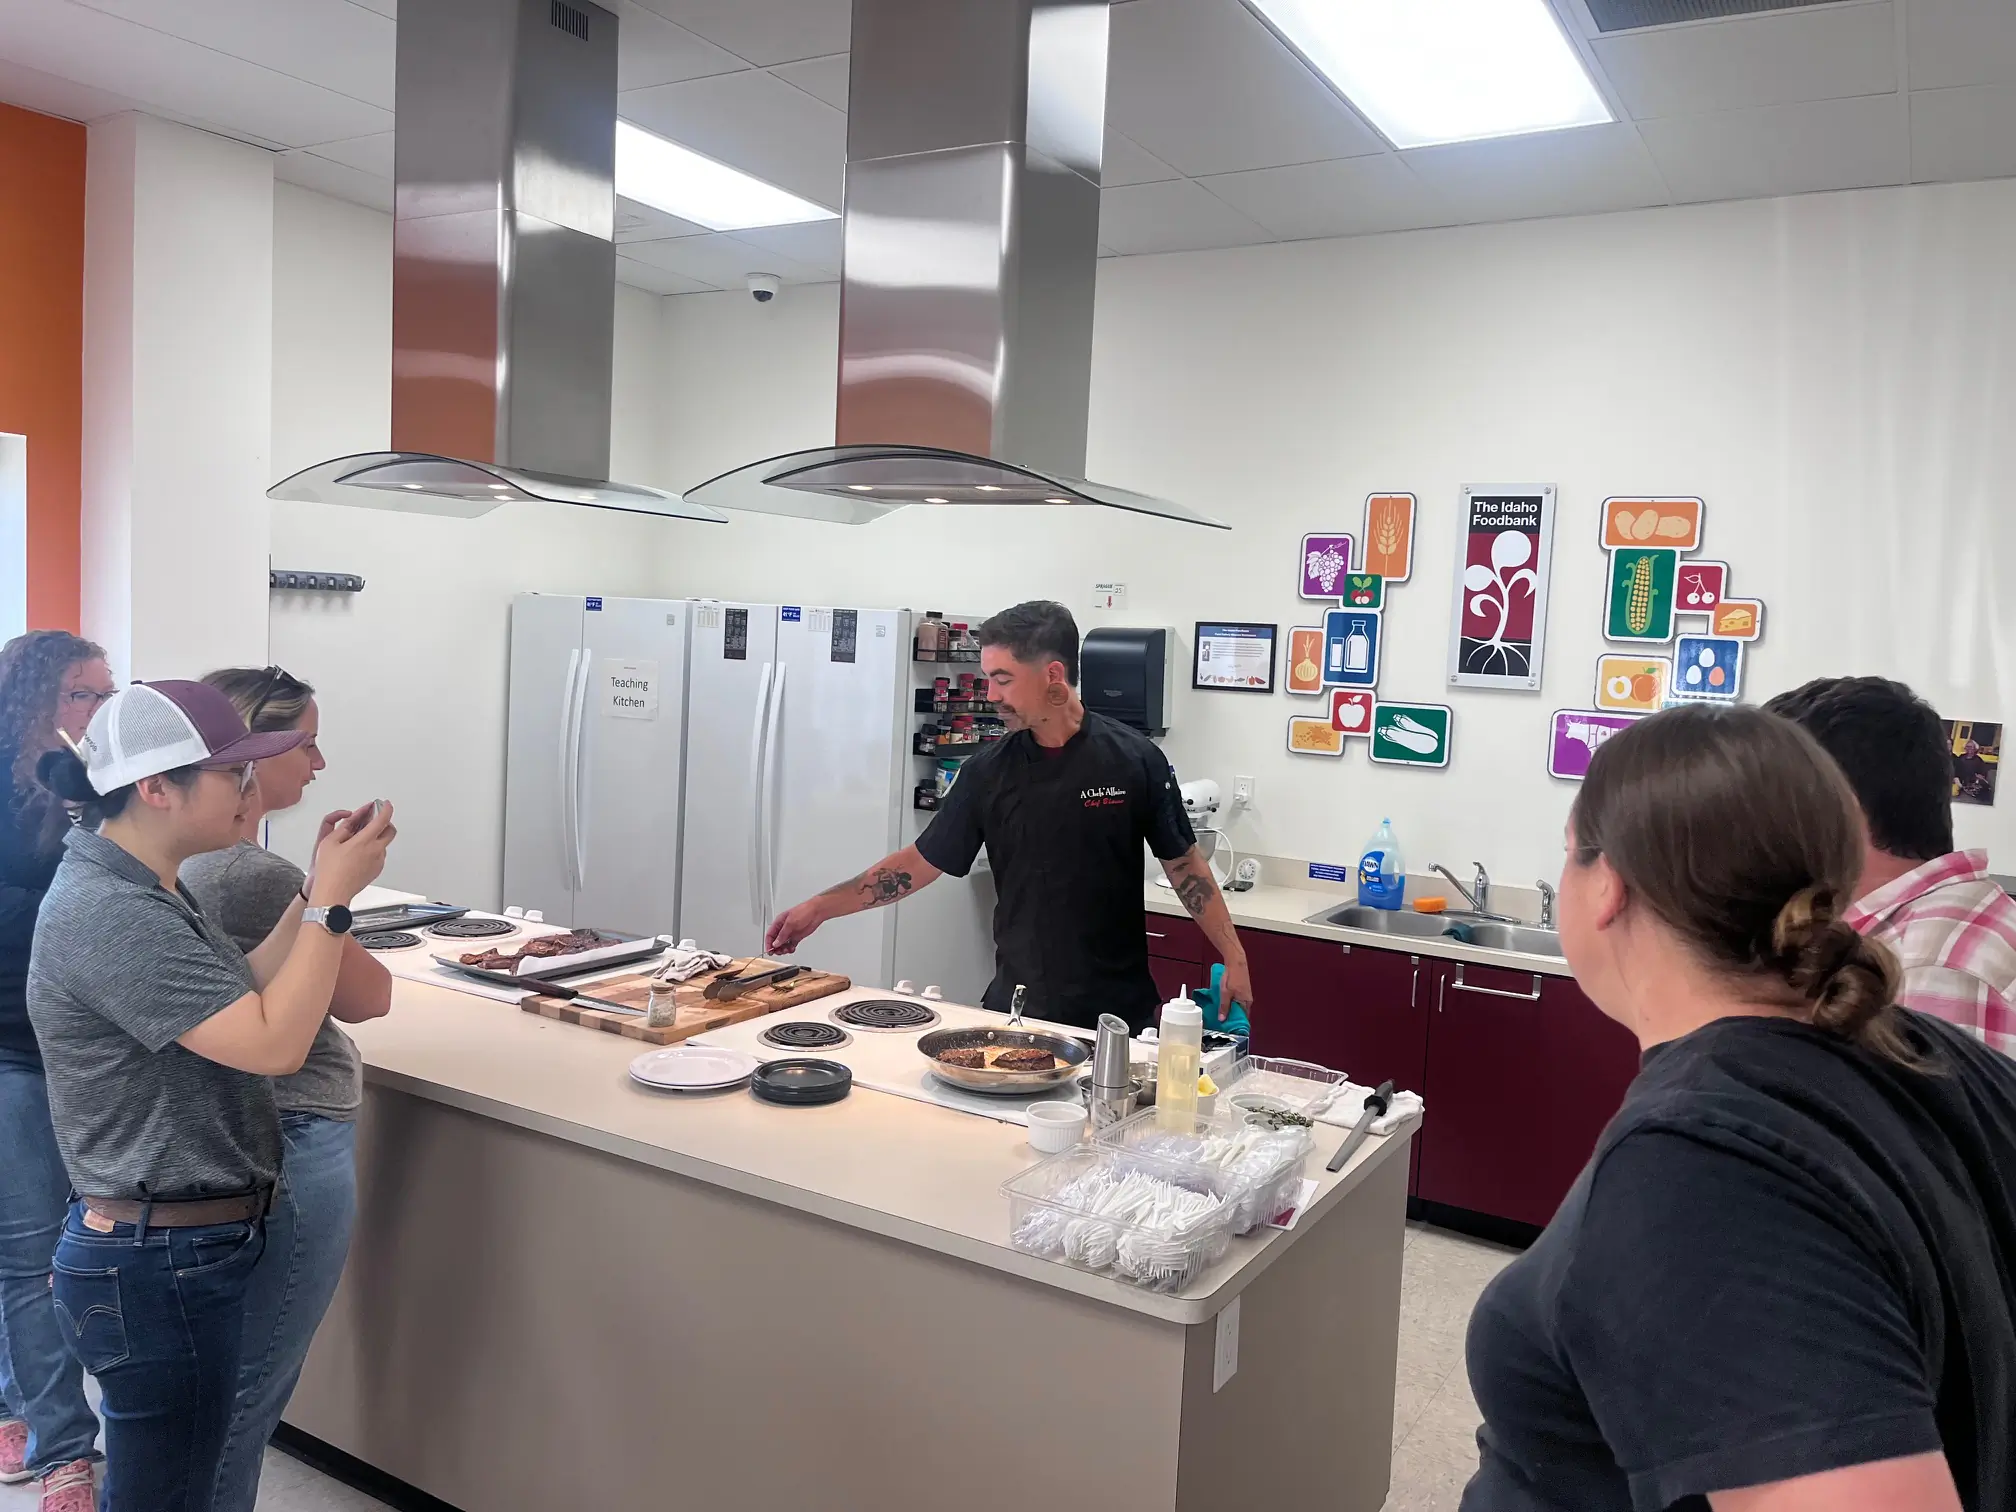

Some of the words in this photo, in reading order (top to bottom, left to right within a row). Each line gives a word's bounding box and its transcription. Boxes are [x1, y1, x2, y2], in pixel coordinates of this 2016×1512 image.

[1474, 501, 1498, 513] The
[1501, 501, 1538, 513] Idaho
[1473, 514, 1537, 526] Foodbank
[610, 676, 649, 692] Teaching
[613, 695, 645, 708] Kitchen
[1080, 790, 1087, 799] A
